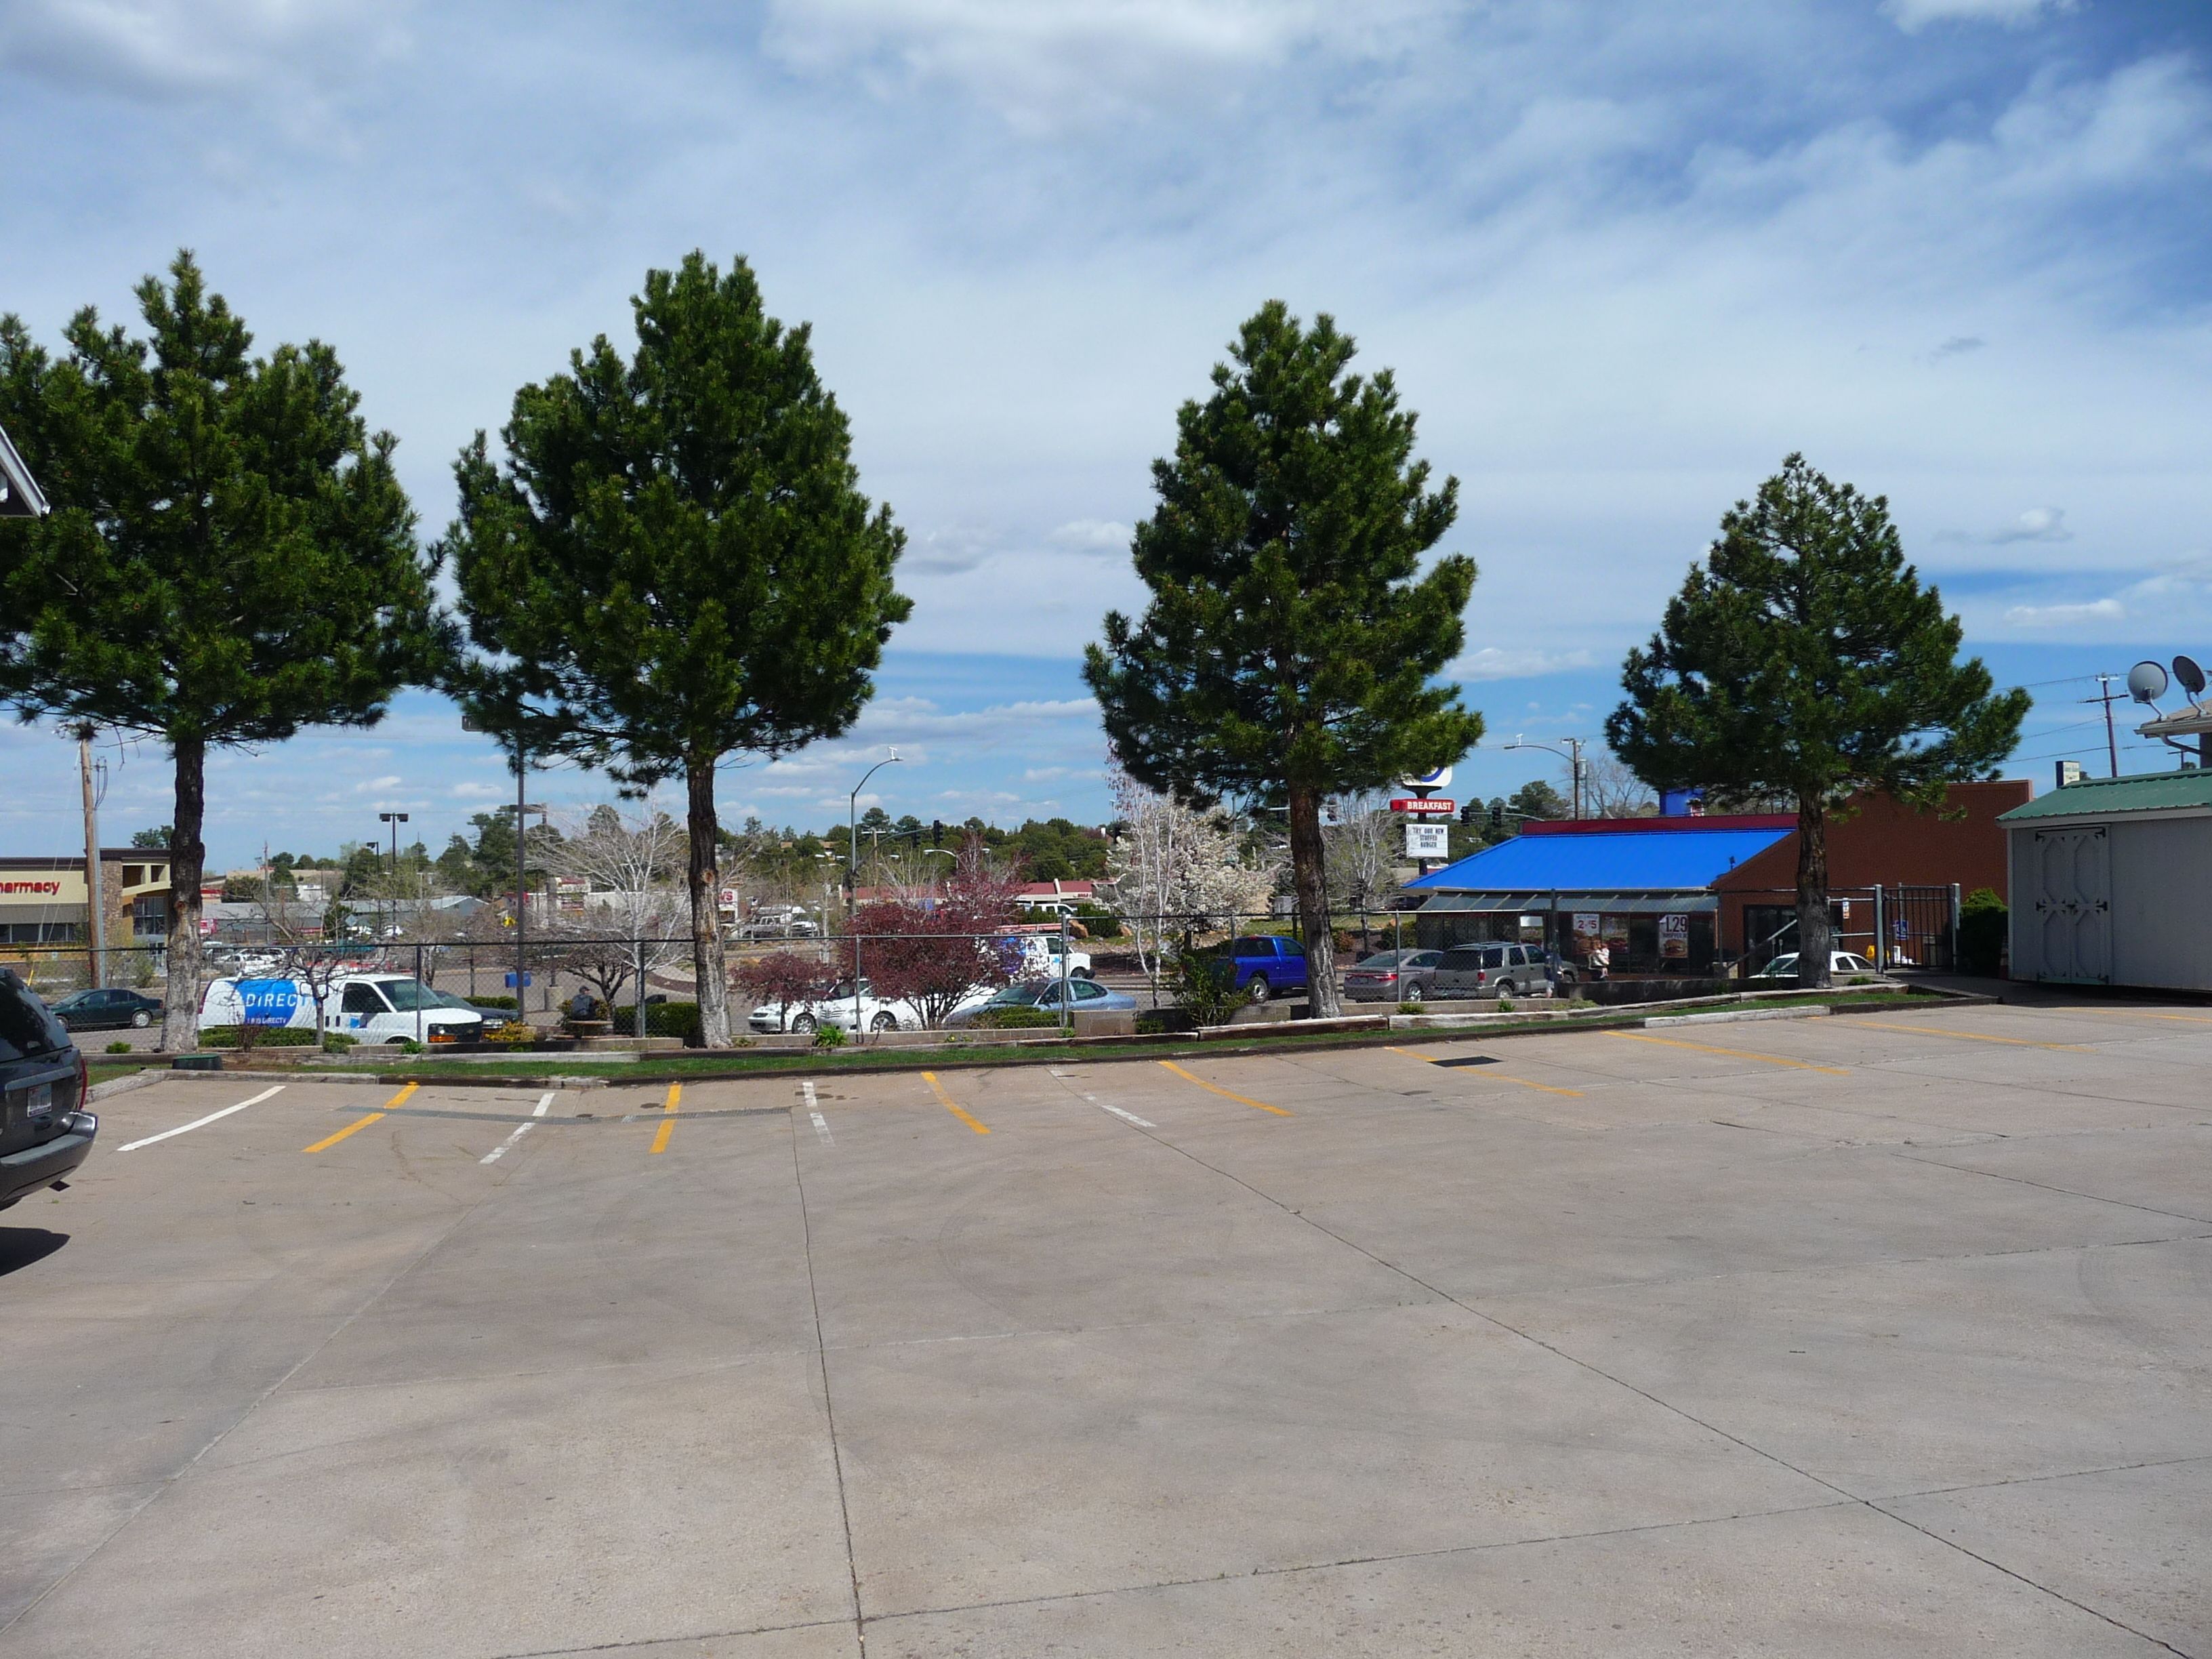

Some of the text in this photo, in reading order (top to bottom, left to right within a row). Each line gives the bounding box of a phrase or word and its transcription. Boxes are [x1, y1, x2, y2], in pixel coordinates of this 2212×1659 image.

[1407, 801, 1452, 811] BREAKFAST
[1578, 920, 1584, 928] 2
[1666, 916, 1687, 933] 1.29
